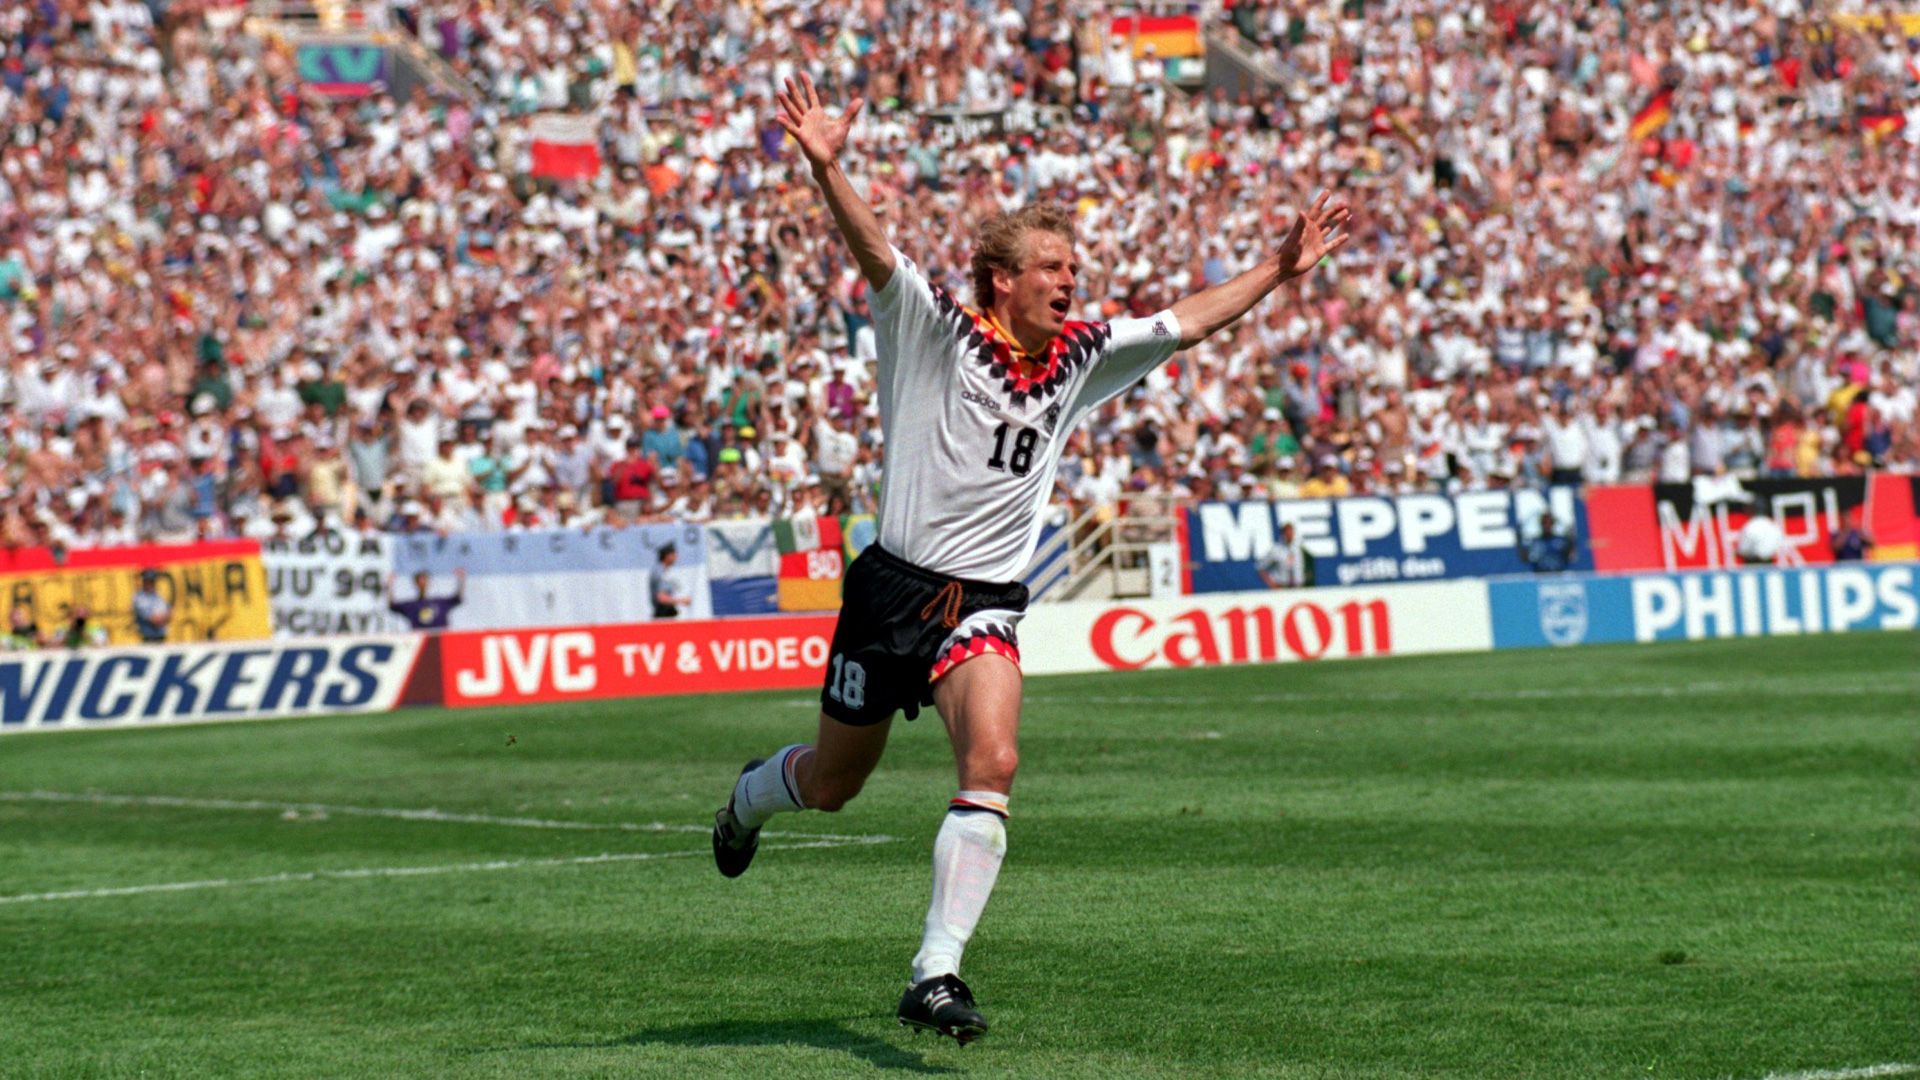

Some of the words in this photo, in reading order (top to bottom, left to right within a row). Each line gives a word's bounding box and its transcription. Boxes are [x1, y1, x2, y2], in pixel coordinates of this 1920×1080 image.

[962, 390, 1001, 412] adidas
[987, 421, 1040, 477] 18
[1201, 487, 1575, 562] MEPPEN
[1089, 598, 1391, 671] Canon
[1632, 568, 1919, 642] PHILIPS
[457, 632, 596, 697] JVC
[615, 643, 666, 676] TV
[676, 641, 702, 672] &
[709, 636, 829, 672] VIDEO
[829, 652, 867, 710] 18
